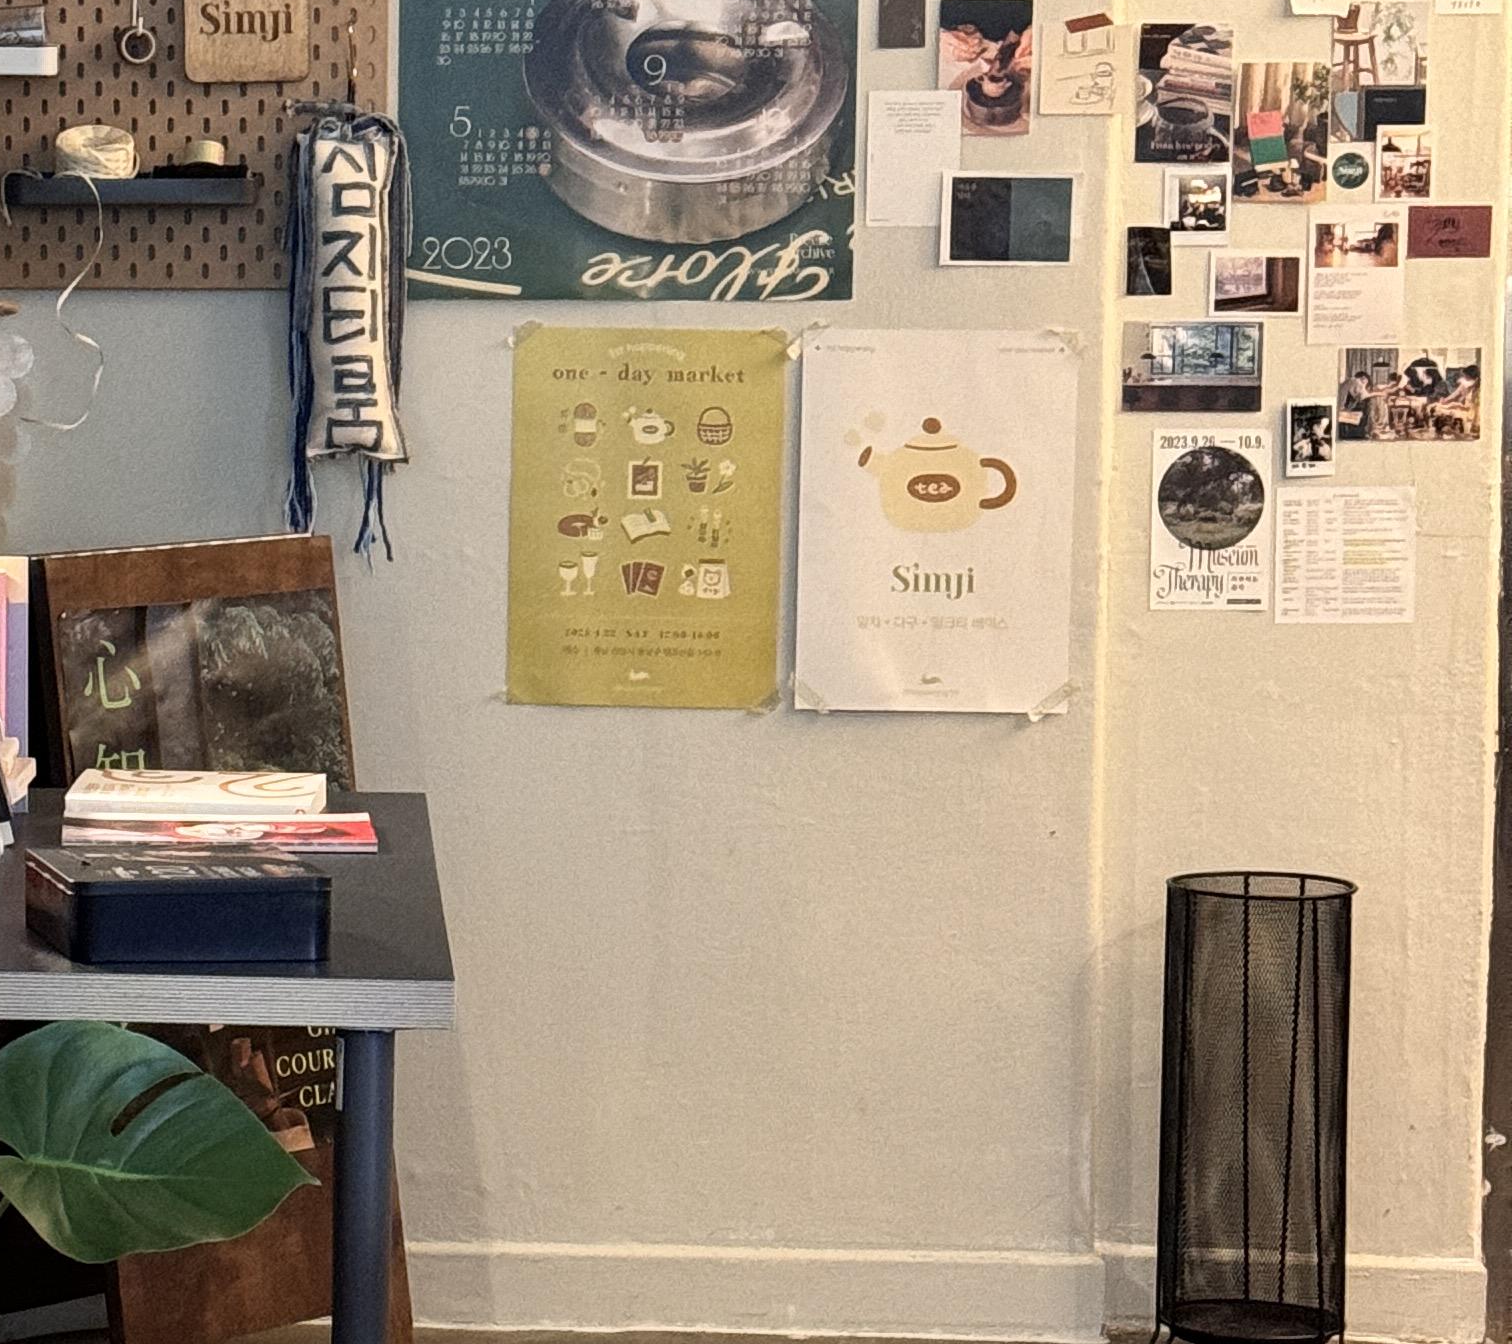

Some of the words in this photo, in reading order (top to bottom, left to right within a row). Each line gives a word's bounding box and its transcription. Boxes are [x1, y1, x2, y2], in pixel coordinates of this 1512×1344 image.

[198, 0, 295, 40] Simji
[644, 54, 667, 86] 9
[449, 106, 472, 137] 5
[422, 237, 512, 271] 2023
[552, 367, 589, 381] one
[618, 363, 653, 385] day
[666, 364, 745, 384] market
[914, 478, 952, 497] tea
[890, 561, 975, 600] Simji
[1153, 562, 1224, 599] Therapy
[276, 1048, 336, 1077] COUR
